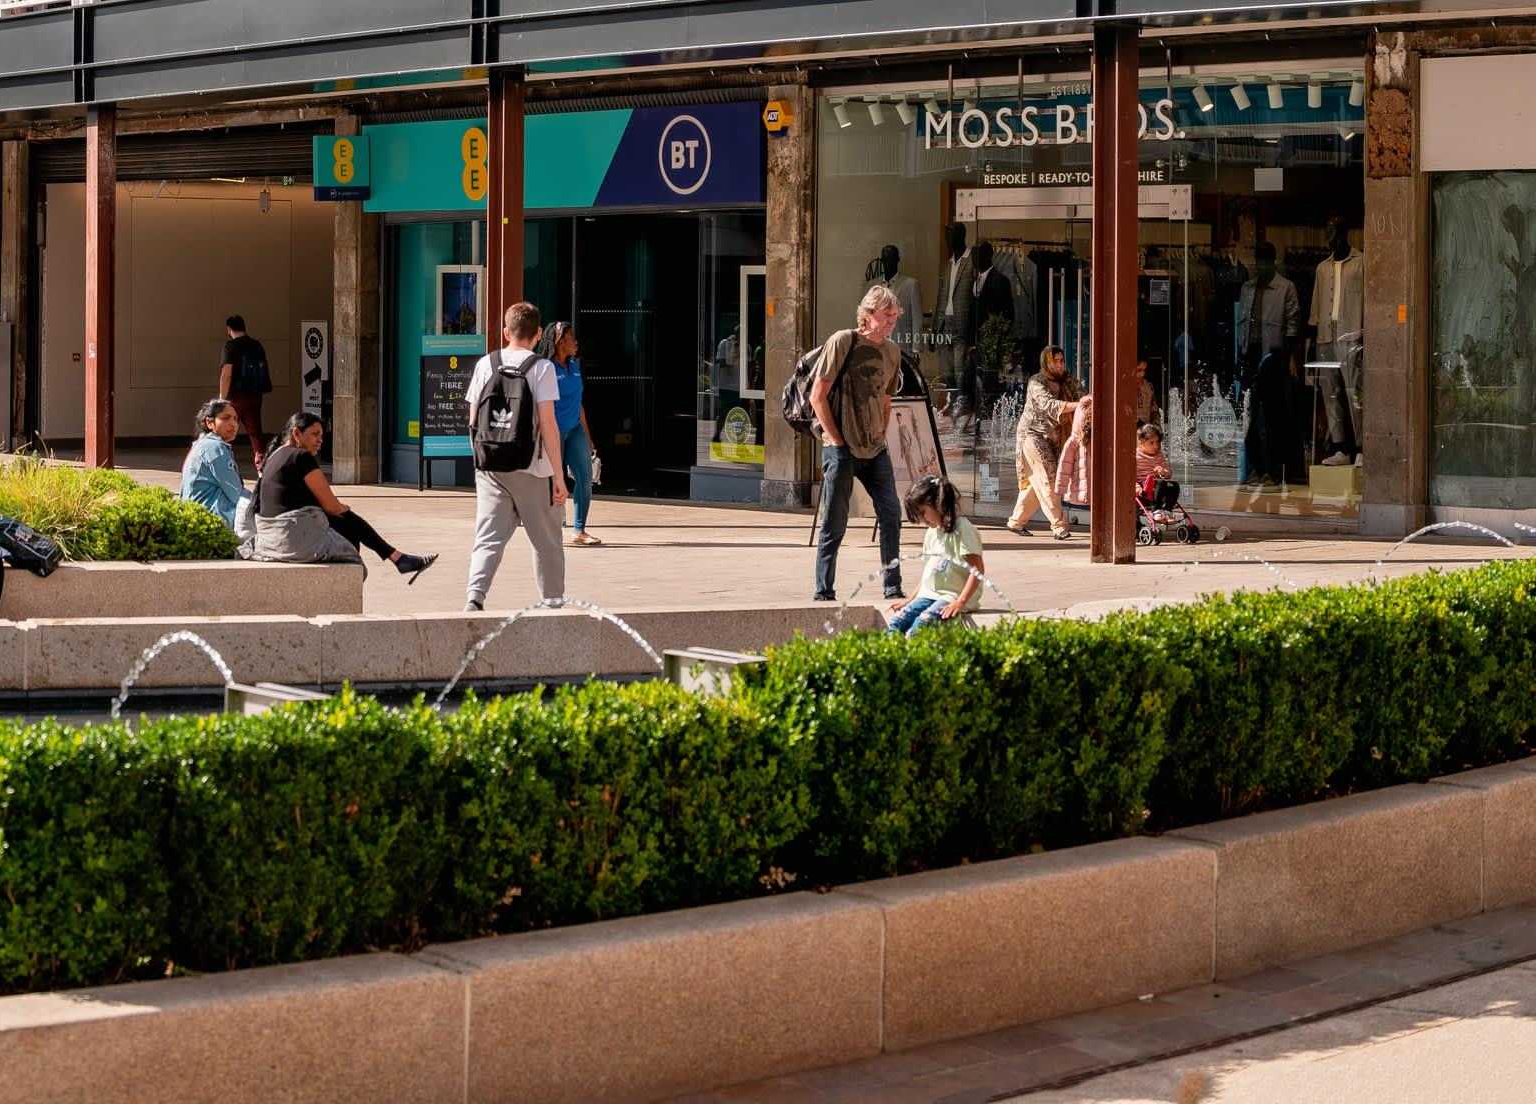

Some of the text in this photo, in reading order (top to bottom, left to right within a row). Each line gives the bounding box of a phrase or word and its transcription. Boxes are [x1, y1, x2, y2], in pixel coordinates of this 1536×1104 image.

[925, 106, 1041, 150] MOSS
[671, 139, 699, 170] BT
[984, 170, 1165, 185] BESPOKE READY-TO- HIRE
[895, 332, 954, 345] LECTION
